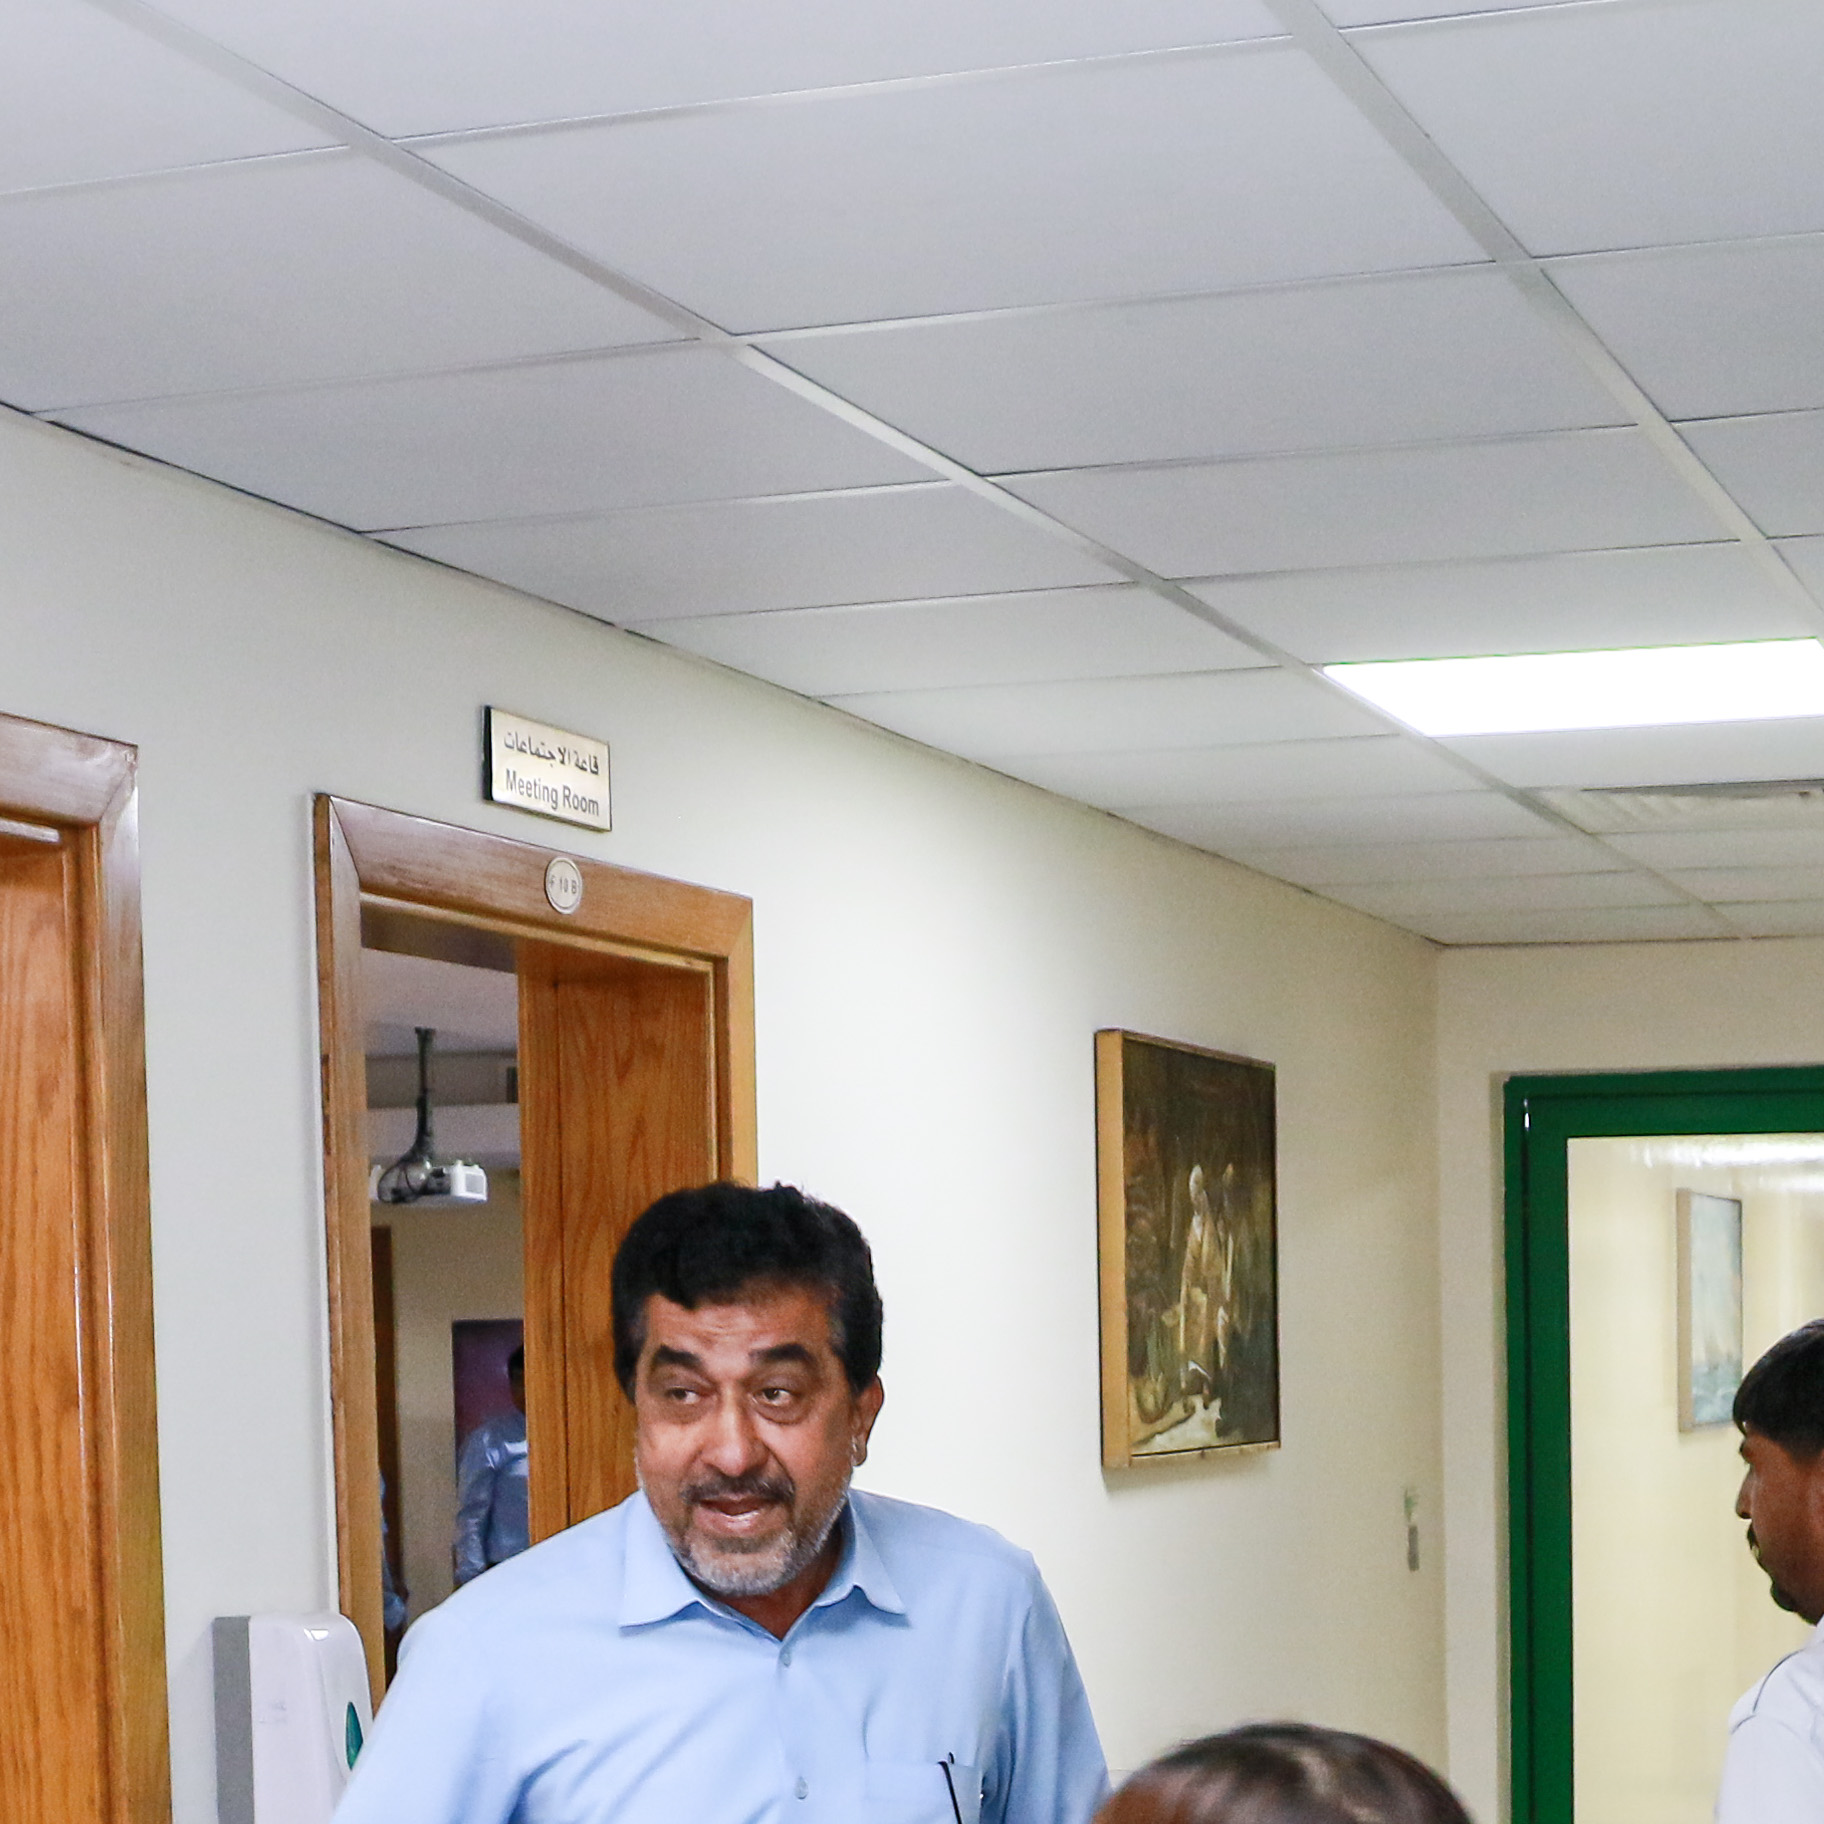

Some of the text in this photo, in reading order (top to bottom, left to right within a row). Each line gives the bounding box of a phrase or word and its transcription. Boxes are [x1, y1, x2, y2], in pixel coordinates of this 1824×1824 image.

[504, 730, 600, 776] قاعة الاجتماعات
[505, 768, 600, 817] Meeting Room
